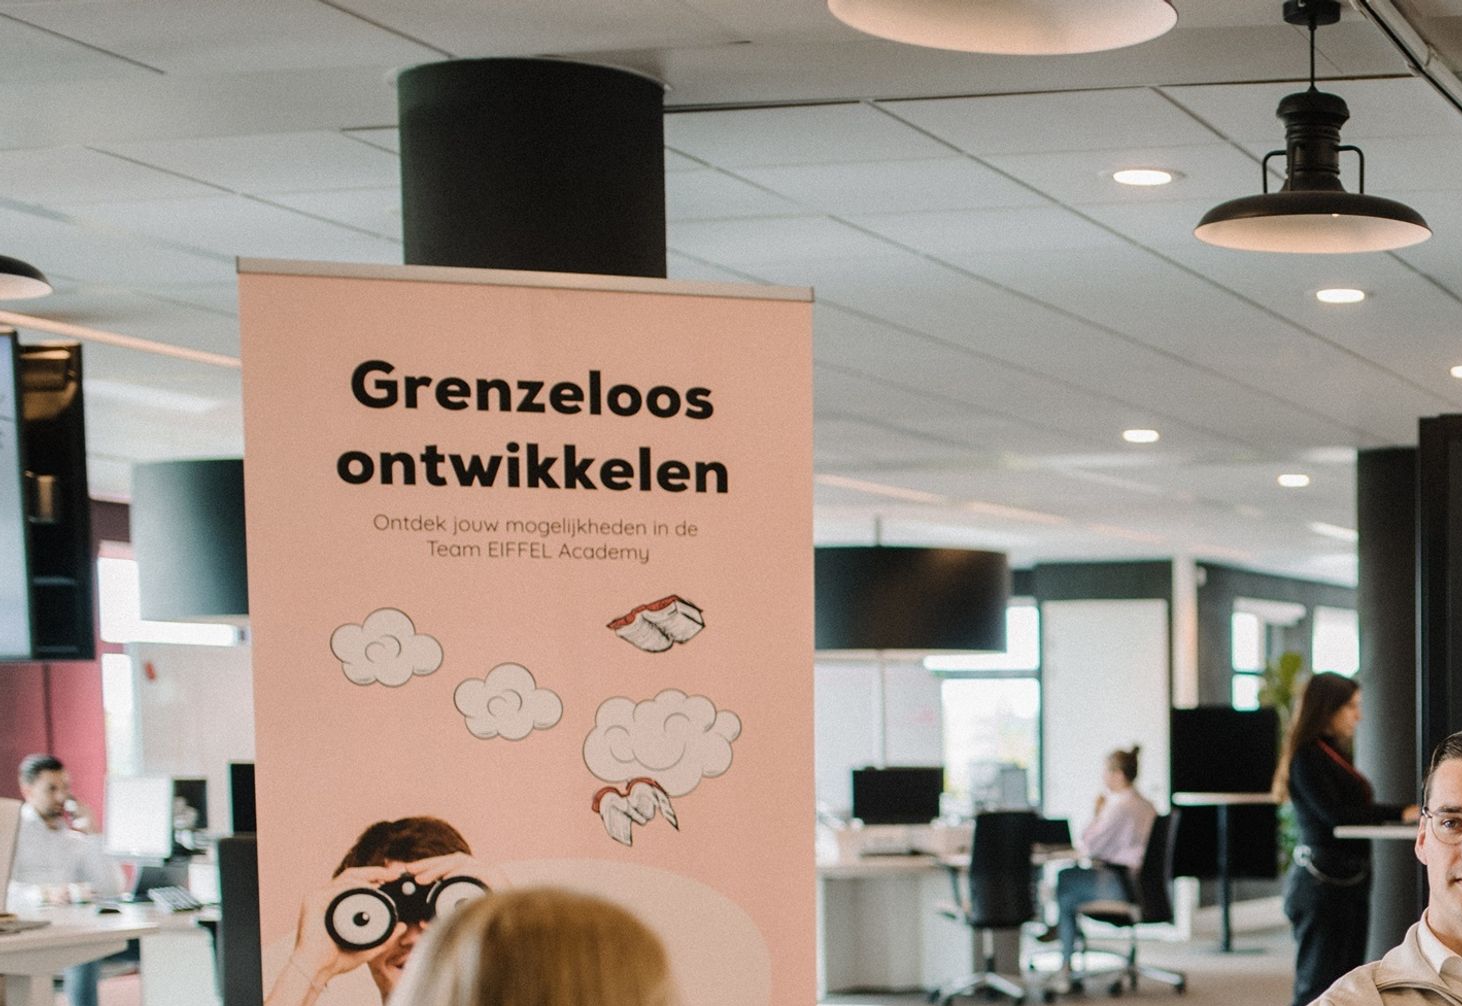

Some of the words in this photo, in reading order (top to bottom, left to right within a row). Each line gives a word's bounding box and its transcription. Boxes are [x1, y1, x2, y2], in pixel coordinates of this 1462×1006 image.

[351, 359, 714, 420] Grenzeloos
[336, 442, 729, 493] ontwikkelen
[373, 513, 447, 533] Ontdek
[452, 515, 500, 534] jouw
[506, 515, 648, 538] mogelijkheden
[653, 520, 669, 536] in
[675, 521, 698, 537] de
[427, 540, 481, 558] Team
[489, 541, 552, 560] EIFFEL
[558, 542, 650, 565] Academy
